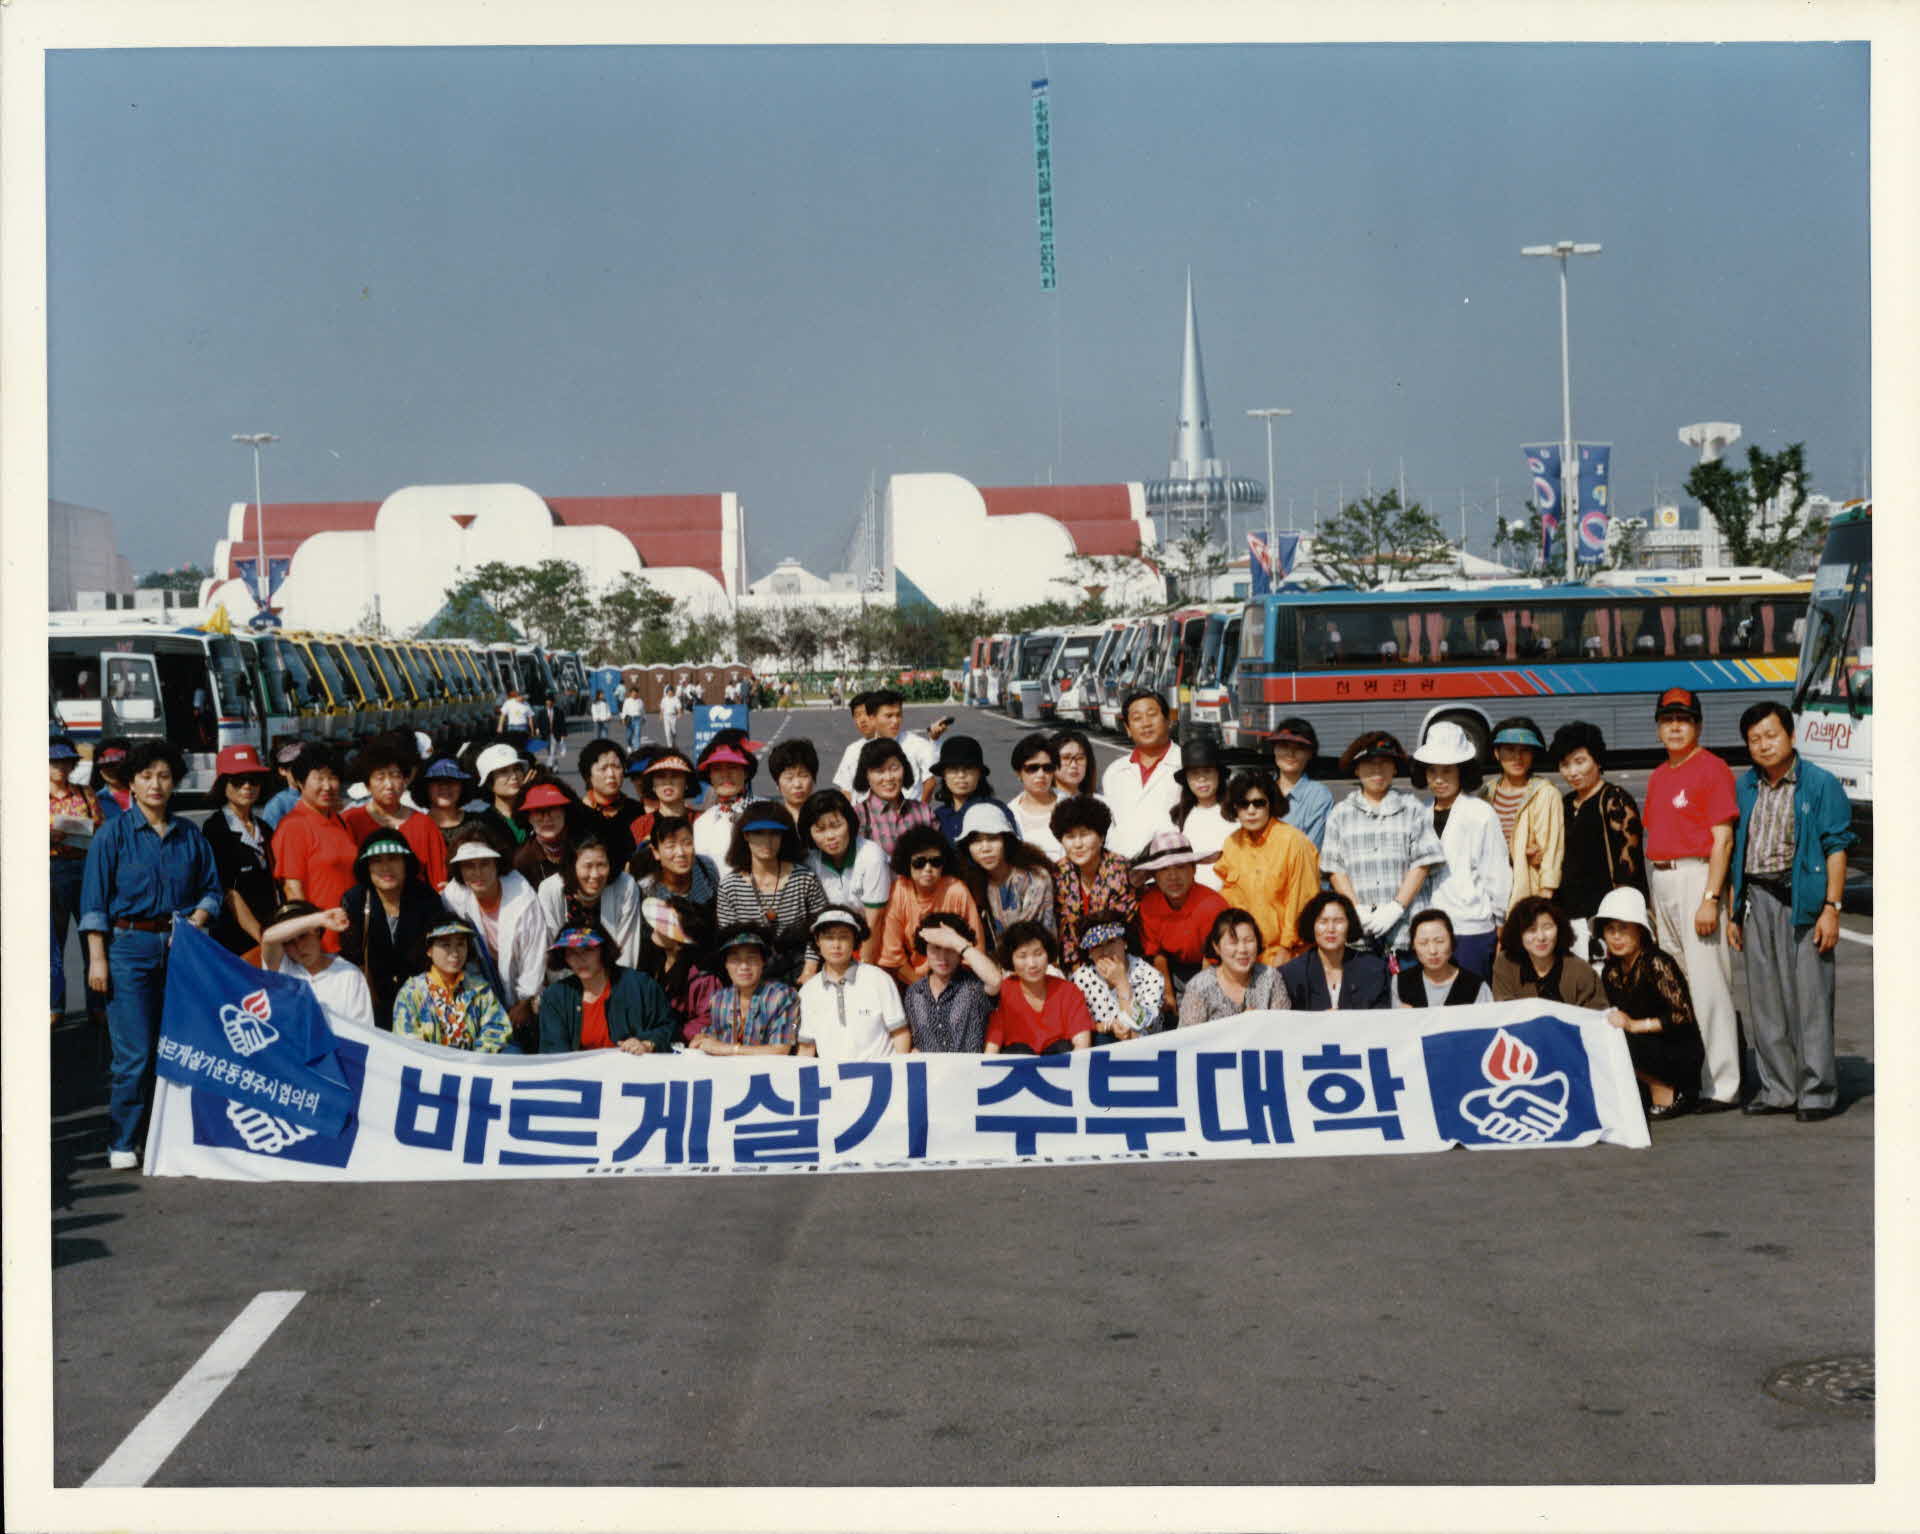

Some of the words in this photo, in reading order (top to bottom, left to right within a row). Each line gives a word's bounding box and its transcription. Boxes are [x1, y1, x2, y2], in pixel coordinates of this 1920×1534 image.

[1804, 720, 1853, 751] 소백산
[395, 1064, 928, 1165] 바르게살기
[976, 1045, 1405, 1155] 주부대학
